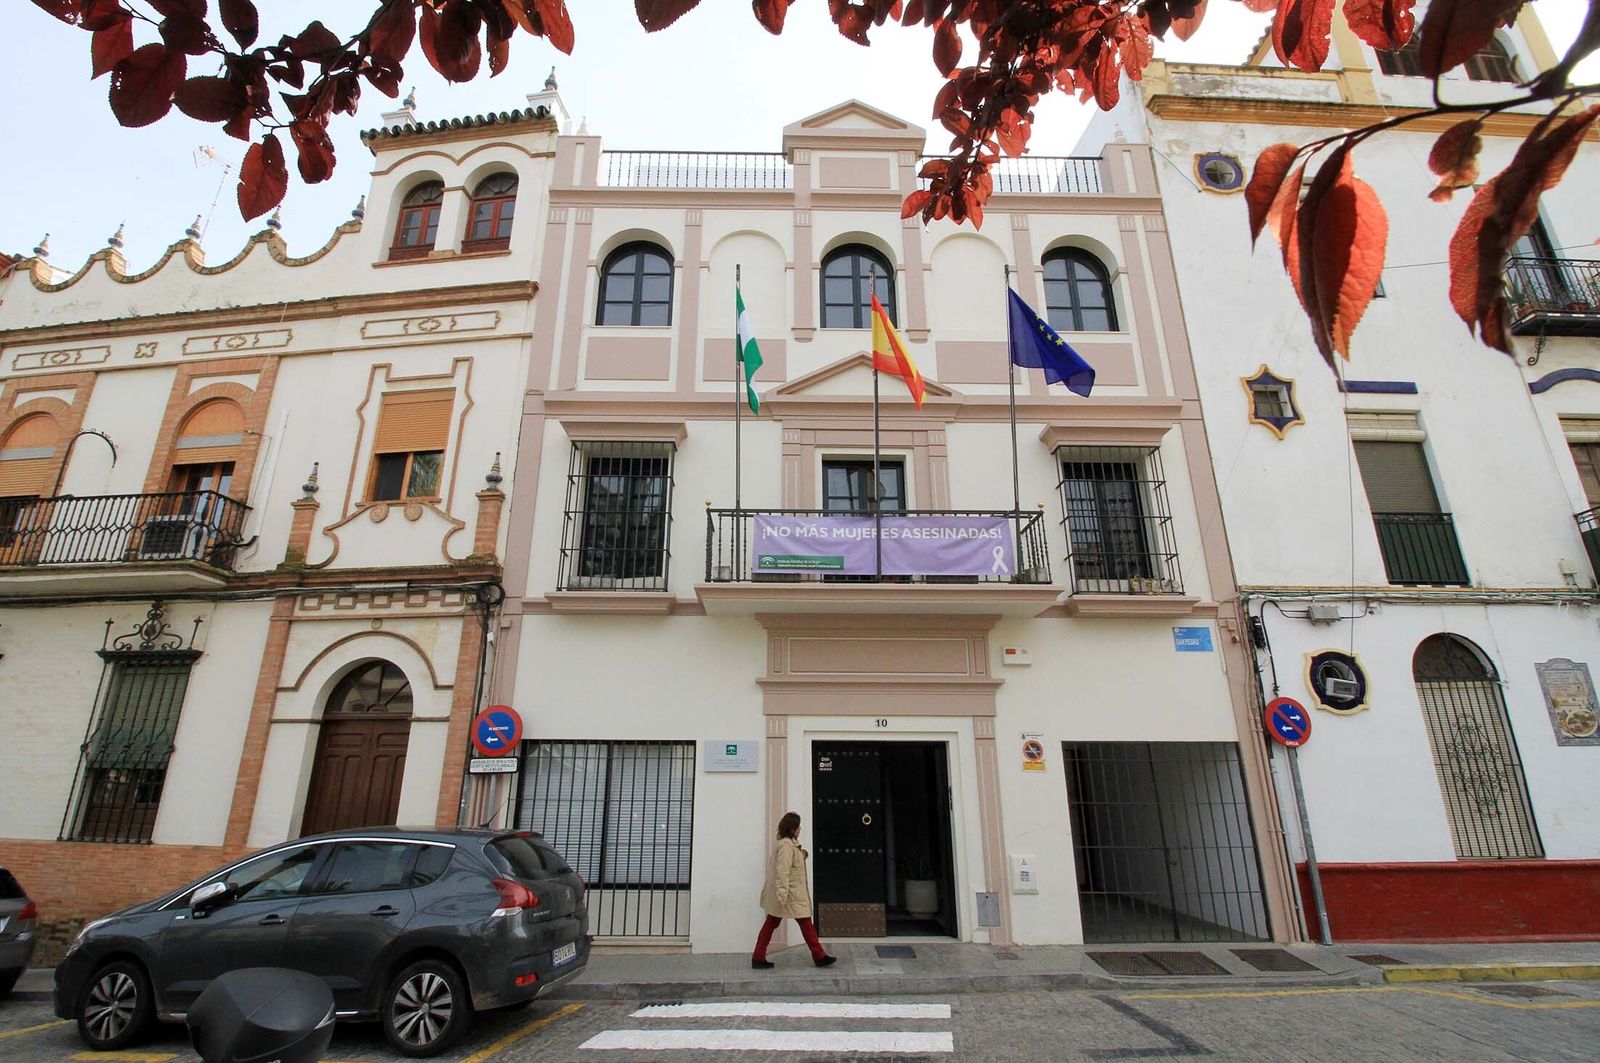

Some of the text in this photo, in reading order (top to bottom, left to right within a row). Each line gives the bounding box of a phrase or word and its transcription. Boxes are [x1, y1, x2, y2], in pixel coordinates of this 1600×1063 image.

[762, 526, 791, 539] ¡NO
[795, 524, 828, 538] MÁS
[901, 527, 1003, 539] ASESINADAS!
[875, 719, 888, 728] 10
